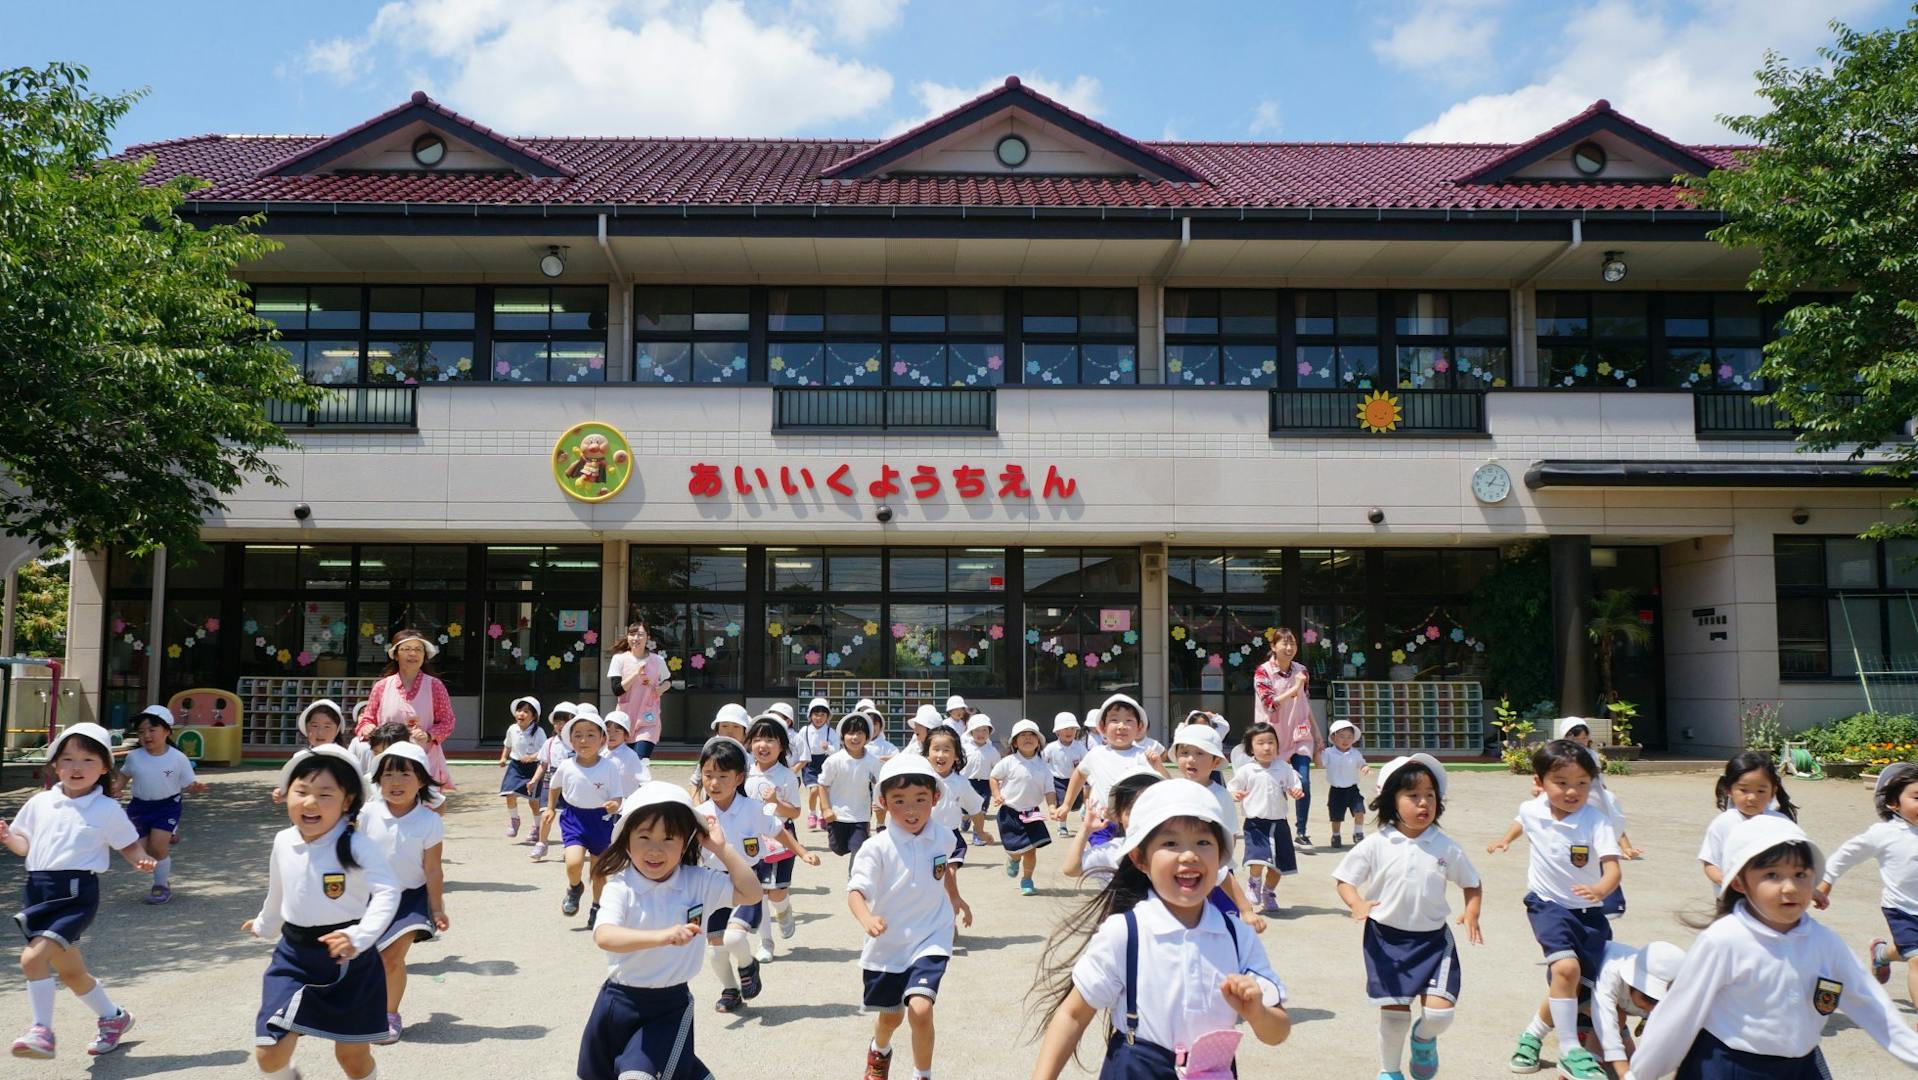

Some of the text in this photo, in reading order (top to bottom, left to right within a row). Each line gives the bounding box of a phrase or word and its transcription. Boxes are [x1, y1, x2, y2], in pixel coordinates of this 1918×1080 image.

[687, 463, 1077, 499] あいいくようちえん
